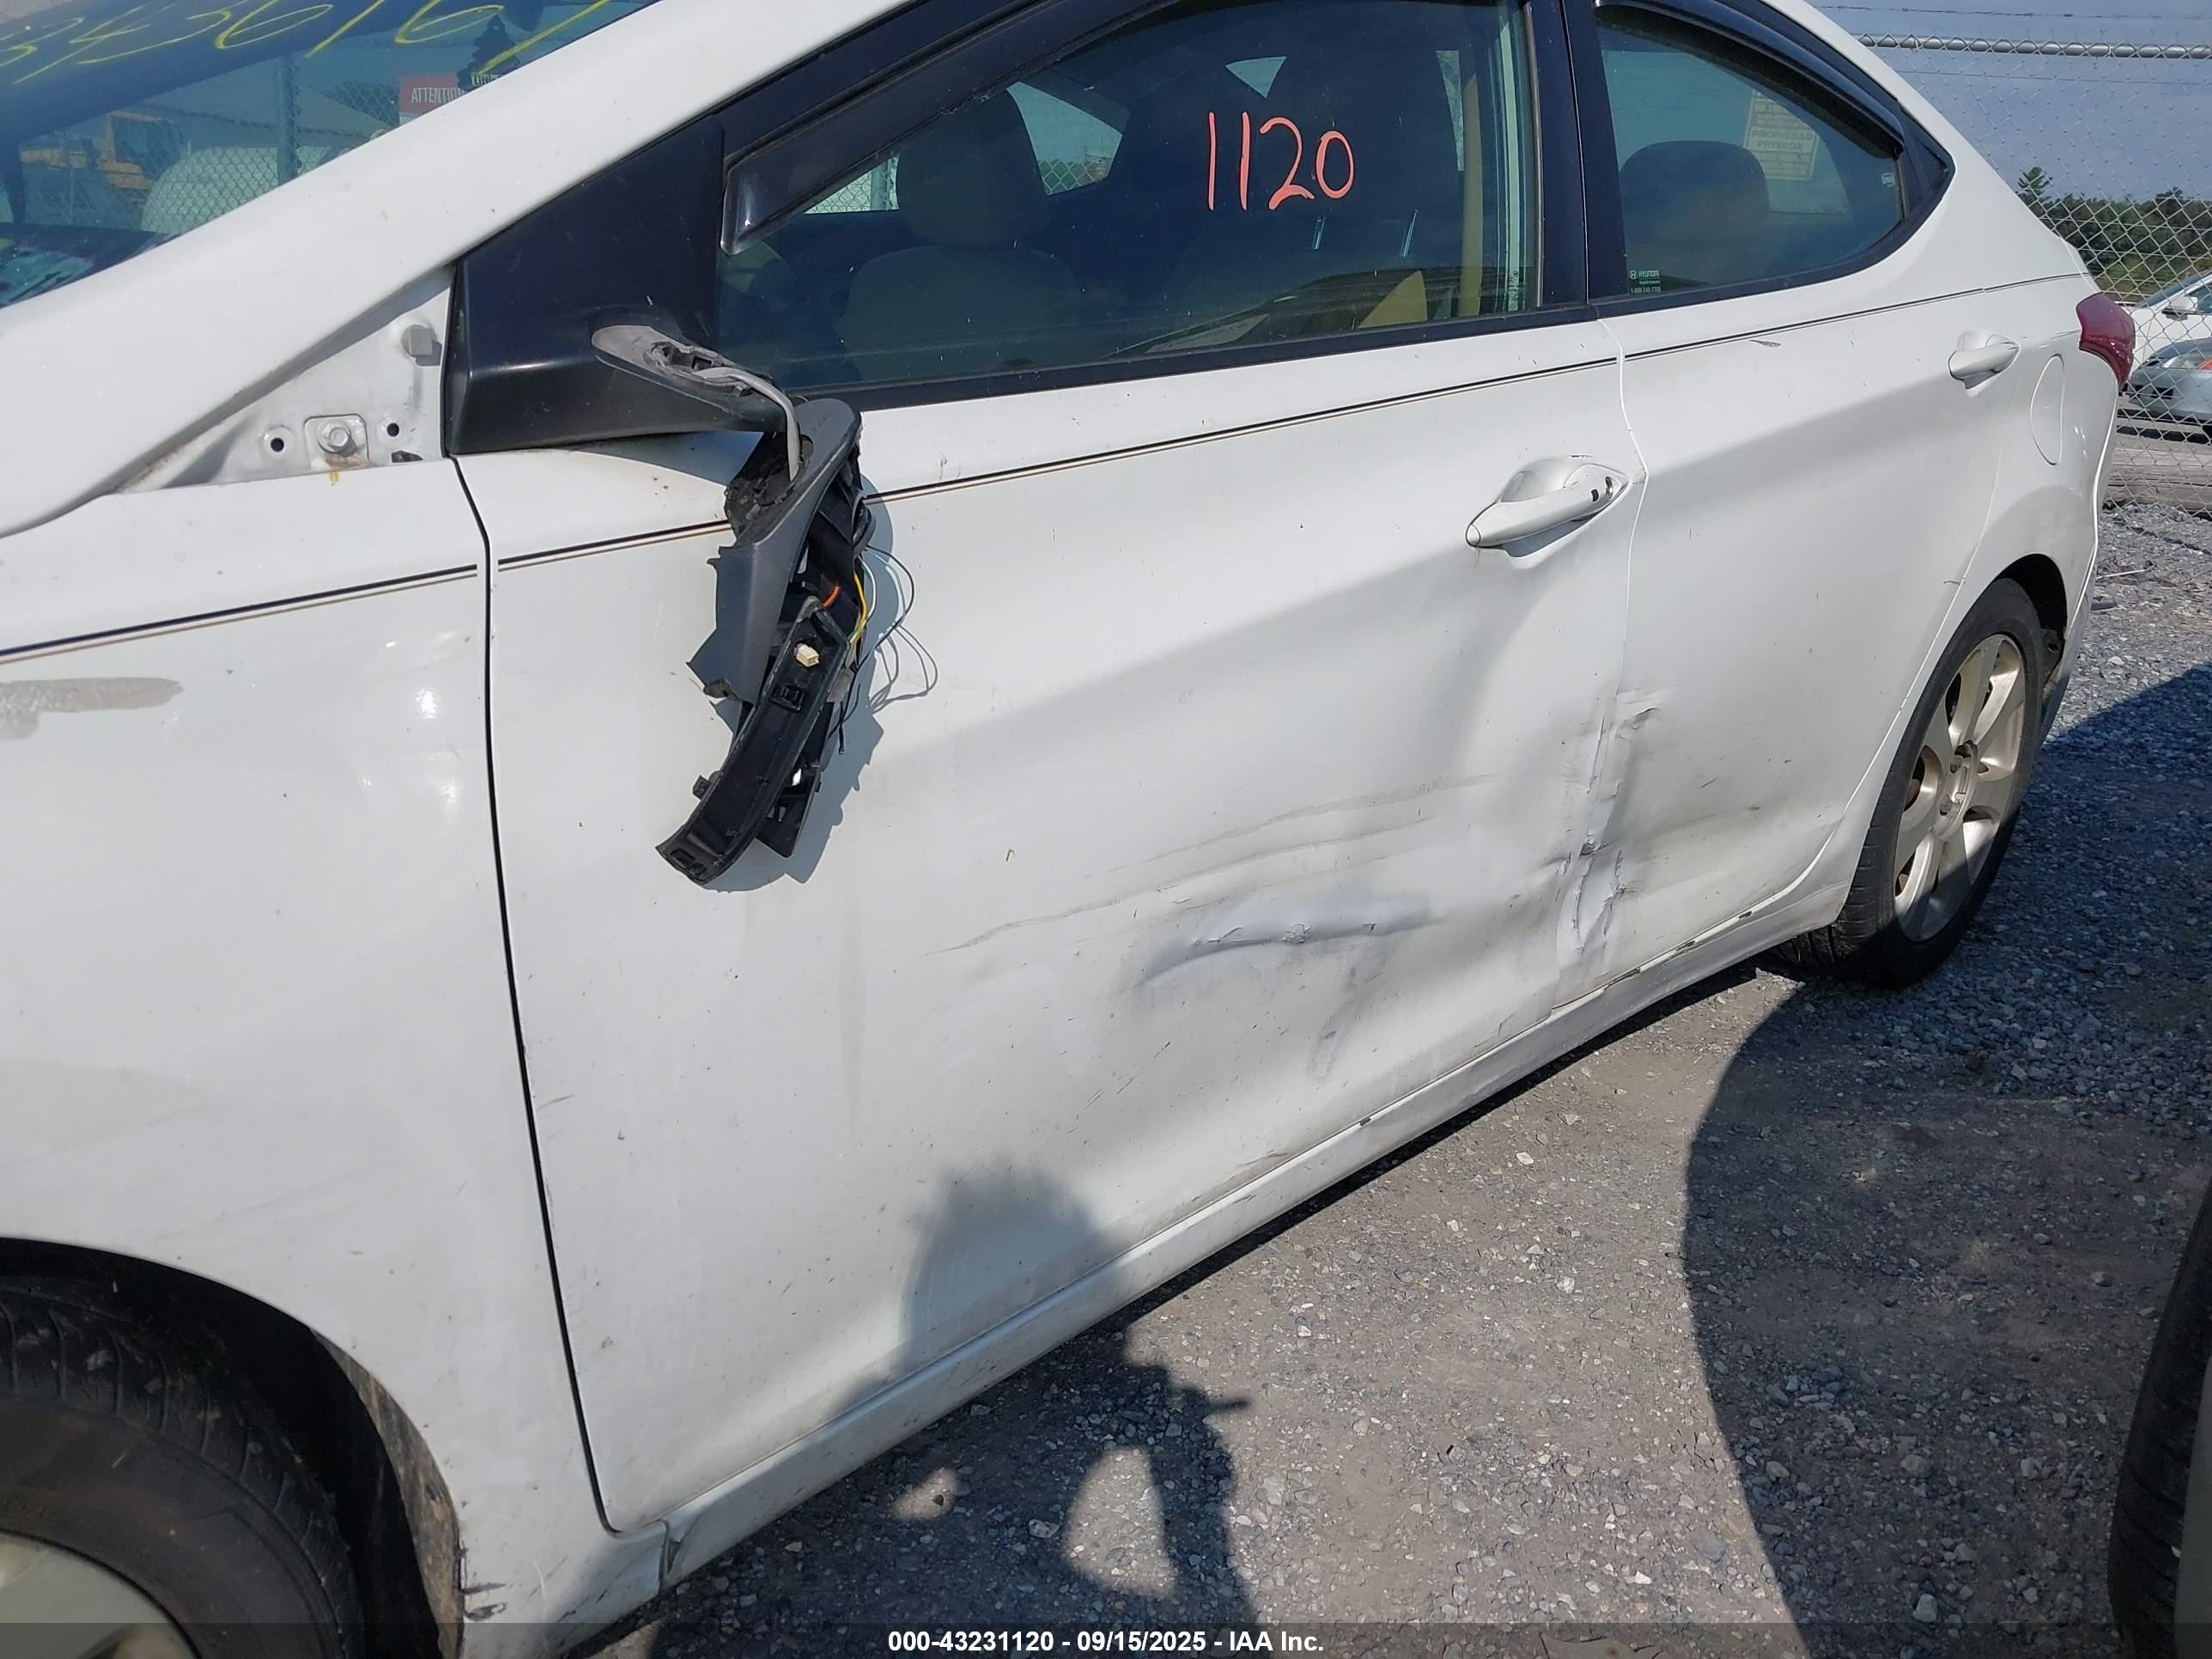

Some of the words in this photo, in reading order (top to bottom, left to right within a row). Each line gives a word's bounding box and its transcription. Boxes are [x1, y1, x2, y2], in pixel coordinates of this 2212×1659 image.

[1752, 129, 1814, 138] PROPIEDAD
[1758, 140, 1803, 150] PRIVADA
[1207, 111, 1355, 211] 1120
